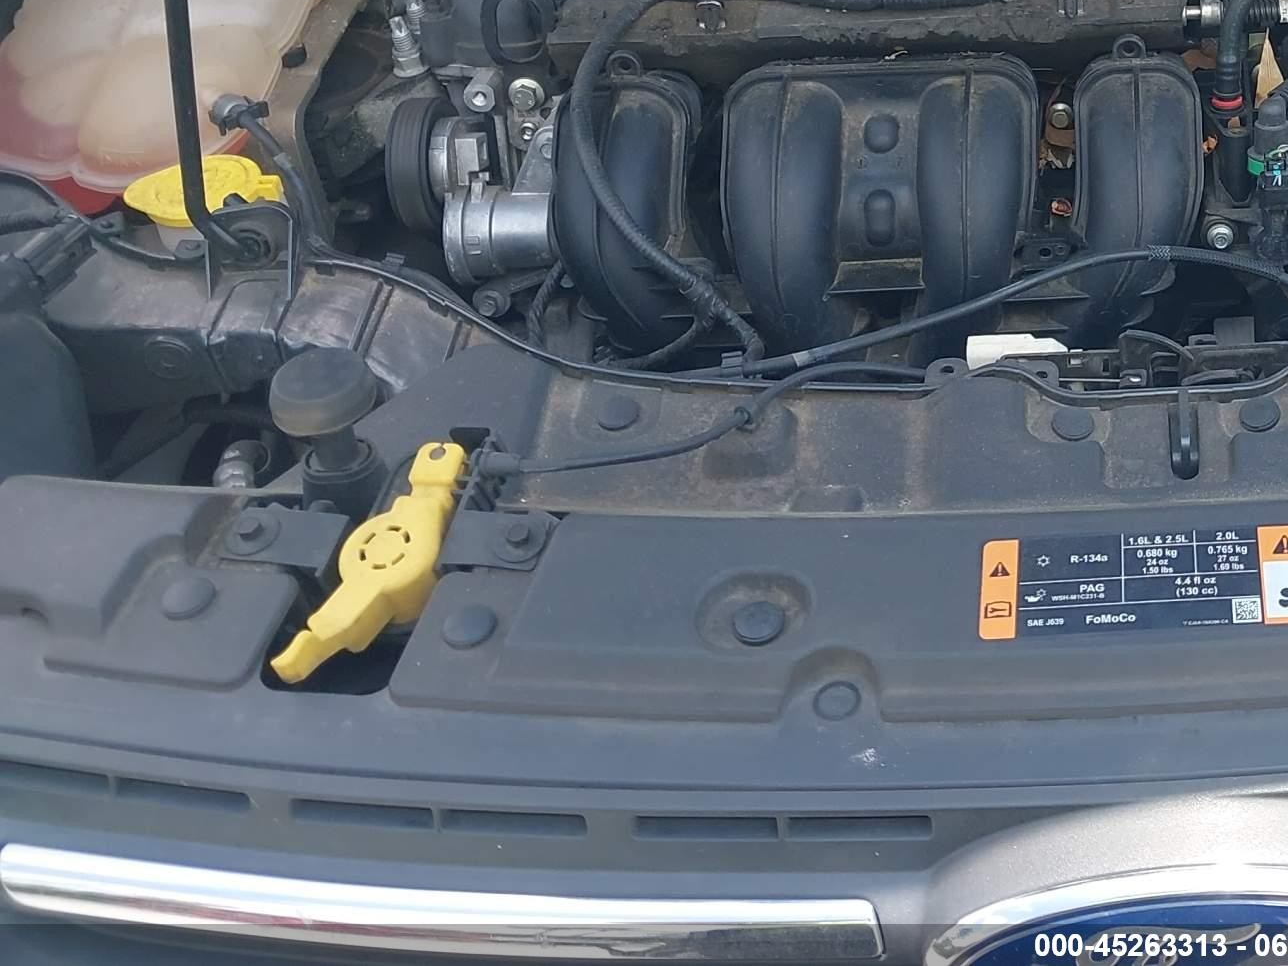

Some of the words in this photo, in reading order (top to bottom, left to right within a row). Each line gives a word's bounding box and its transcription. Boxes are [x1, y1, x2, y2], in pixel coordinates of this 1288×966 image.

[1128, 536, 1152, 546] 1.6L
[1154, 536, 1162, 544] &
[1165, 534, 1189, 544] 2.5L
[1216, 531, 1239, 541] 2.0L
[1136, 548, 1163, 558] 0.680
[1165, 547, 1178, 558] kg
[1207, 545, 1234, 555] 0.765
[1235, 544, 1248, 554] kg
[1070, 553, 1109, 564] R-134a
[1142, 566, 1159, 574] 1.50
[1160, 566, 1174, 574] lbs
[1174, 576, 1192, 585] 4.4
[1193, 576, 1201, 585] fl
[1079, 583, 1105, 593] PAG
[1176, 586, 1199, 597] (130
[1201, 586, 1218, 596] cc)
[1027, 618, 1044, 627] SAE
[1045, 617, 1065, 626] J639
[1085, 613, 1137, 625] FoMoCo
